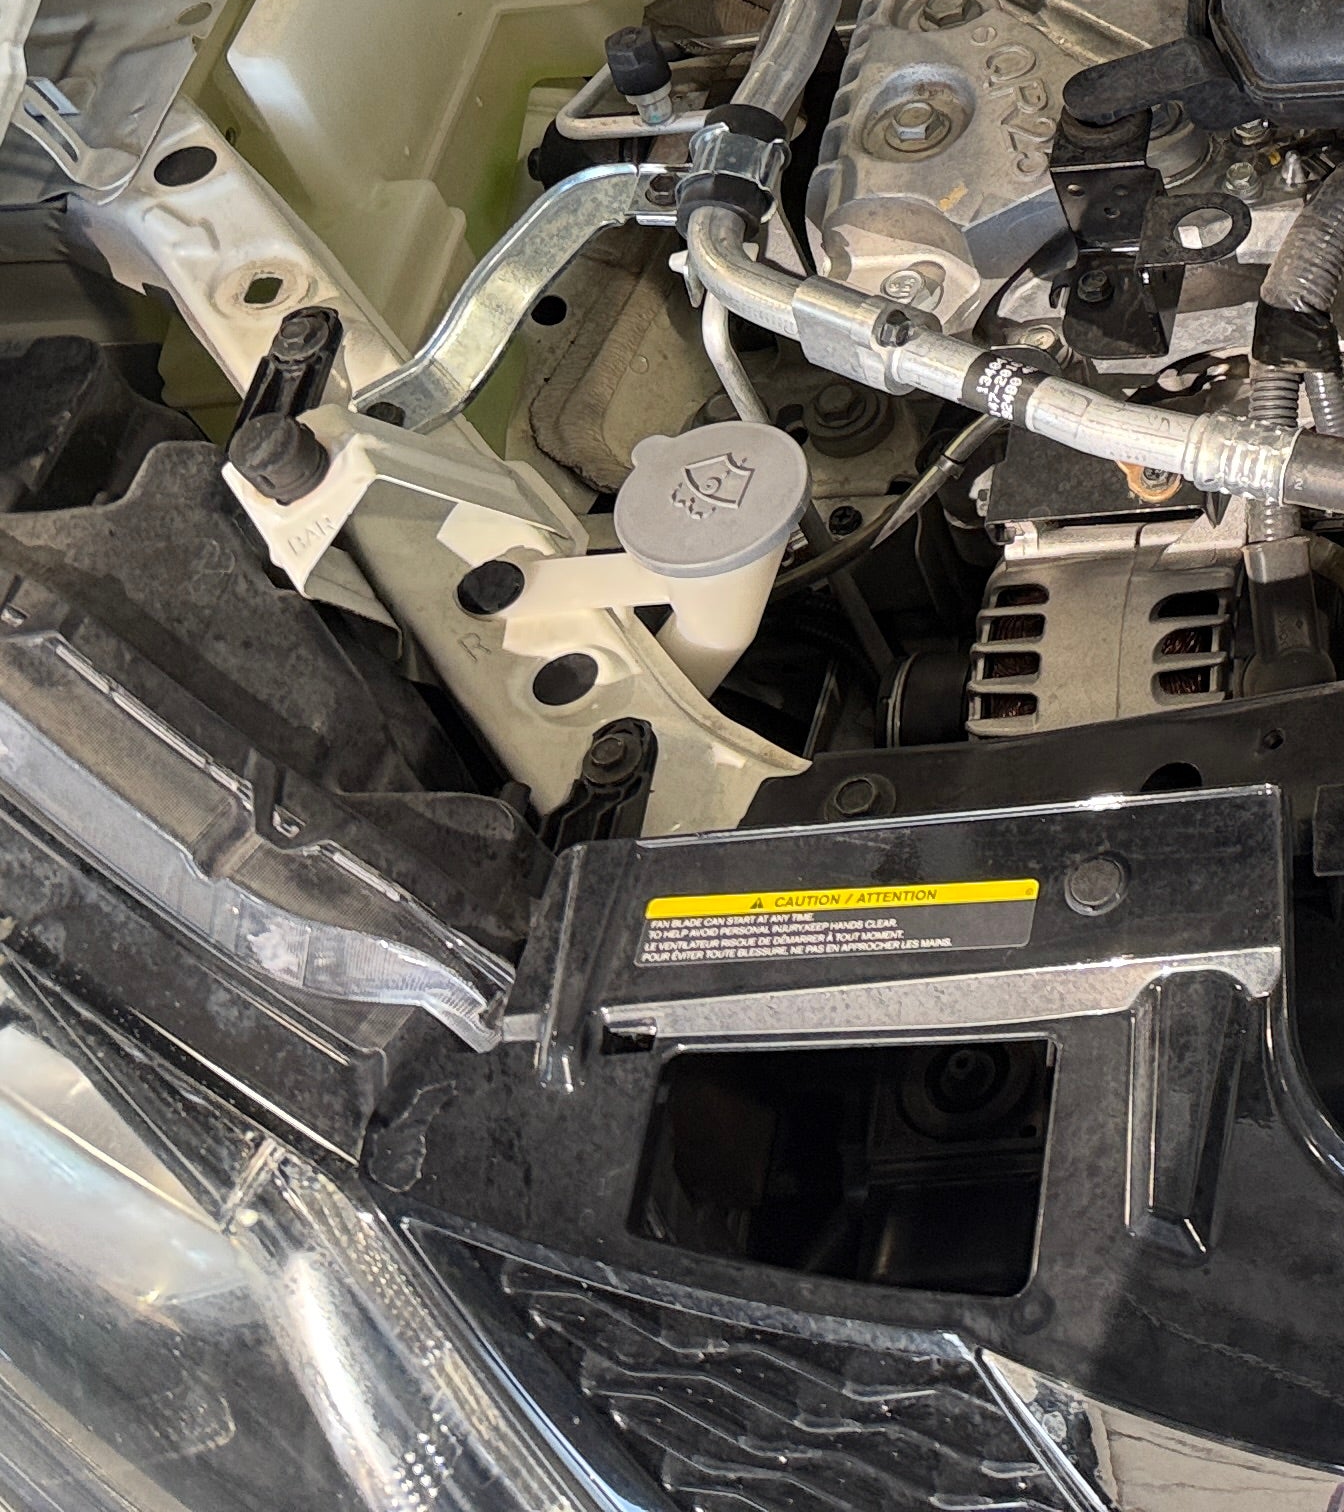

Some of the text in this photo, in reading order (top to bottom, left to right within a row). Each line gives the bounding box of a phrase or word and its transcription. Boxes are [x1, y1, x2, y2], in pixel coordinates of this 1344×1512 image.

[775, 895, 840, 908] CAUTION
[857, 890, 937, 903] ATTENTION
[648, 931, 661, 939] TO
[663, 929, 688, 938] HELP
[690, 928, 718, 937] AVOID
[720, 925, 770, 935] PERSONAL
[830, 921, 862, 930] HANDS
[865, 919, 898, 929] CLEAR.
[651, 913, 814, 929] FAN BLADE CAN START AT ANY TIME.
[642, 953, 670, 962] POUR
[671, 950, 704, 961] ÉVITER
[706, 950, 736, 960] TOUTE
[791, 946, 804, 955] NE
[805, 945, 824, 954] PAS
[826, 944, 839, 953] EN
[840, 940, 900, 952] APPROCHER
[902, 940, 919, 949] LES
[644, 943, 657, 952] LE
[658, 939, 719, 951] VENTILATEUR
[721, 938, 756, 948] RISQUE
[758, 937, 771, 946] DE
[773, 934, 825, 945] DÉMARRER
[835, 933, 859, 941] TOUT
[861, 930, 904, 940] MOMENT.
